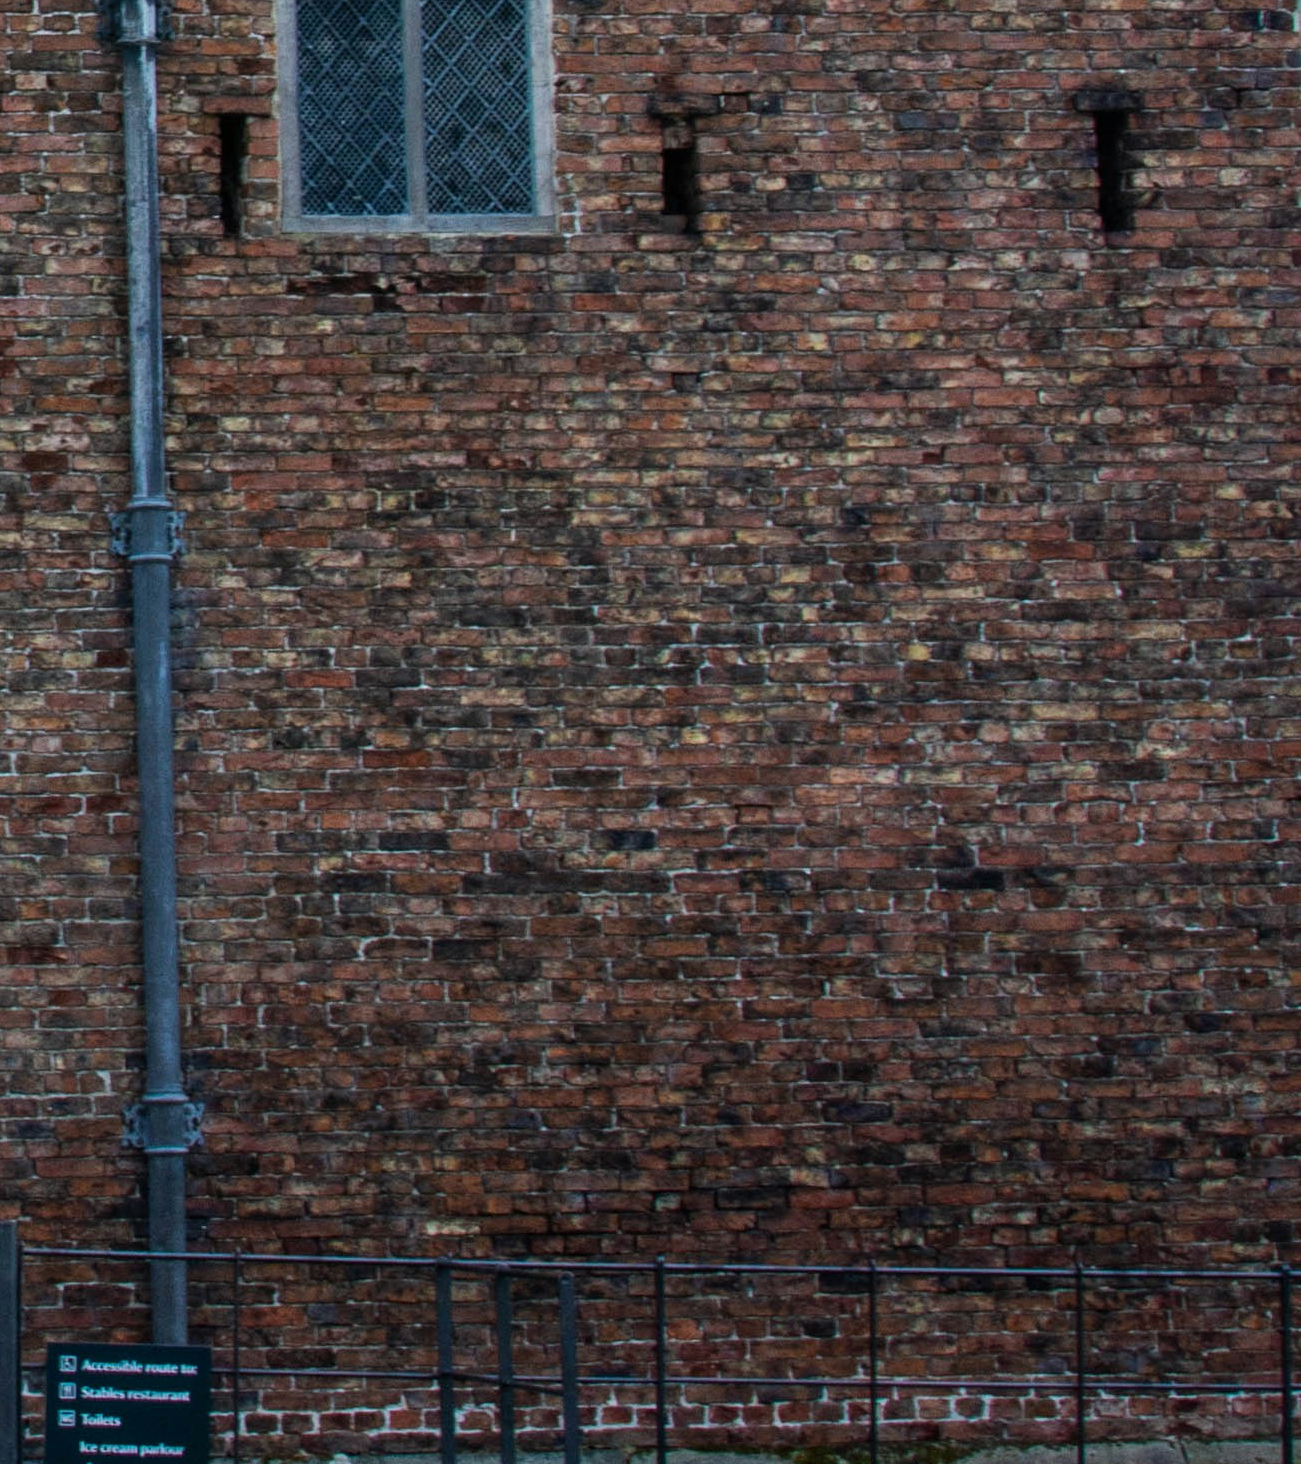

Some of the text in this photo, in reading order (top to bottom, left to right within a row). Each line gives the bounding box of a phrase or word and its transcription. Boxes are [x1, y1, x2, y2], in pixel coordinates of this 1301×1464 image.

[81, 1359, 143, 1373] Accessible
[144, 1363, 179, 1374] route
[80, 1385, 190, 1402] Stables restaurant
[80, 1413, 122, 1427] Toilets
[79, 1440, 185, 1458] Ice cream parlour
